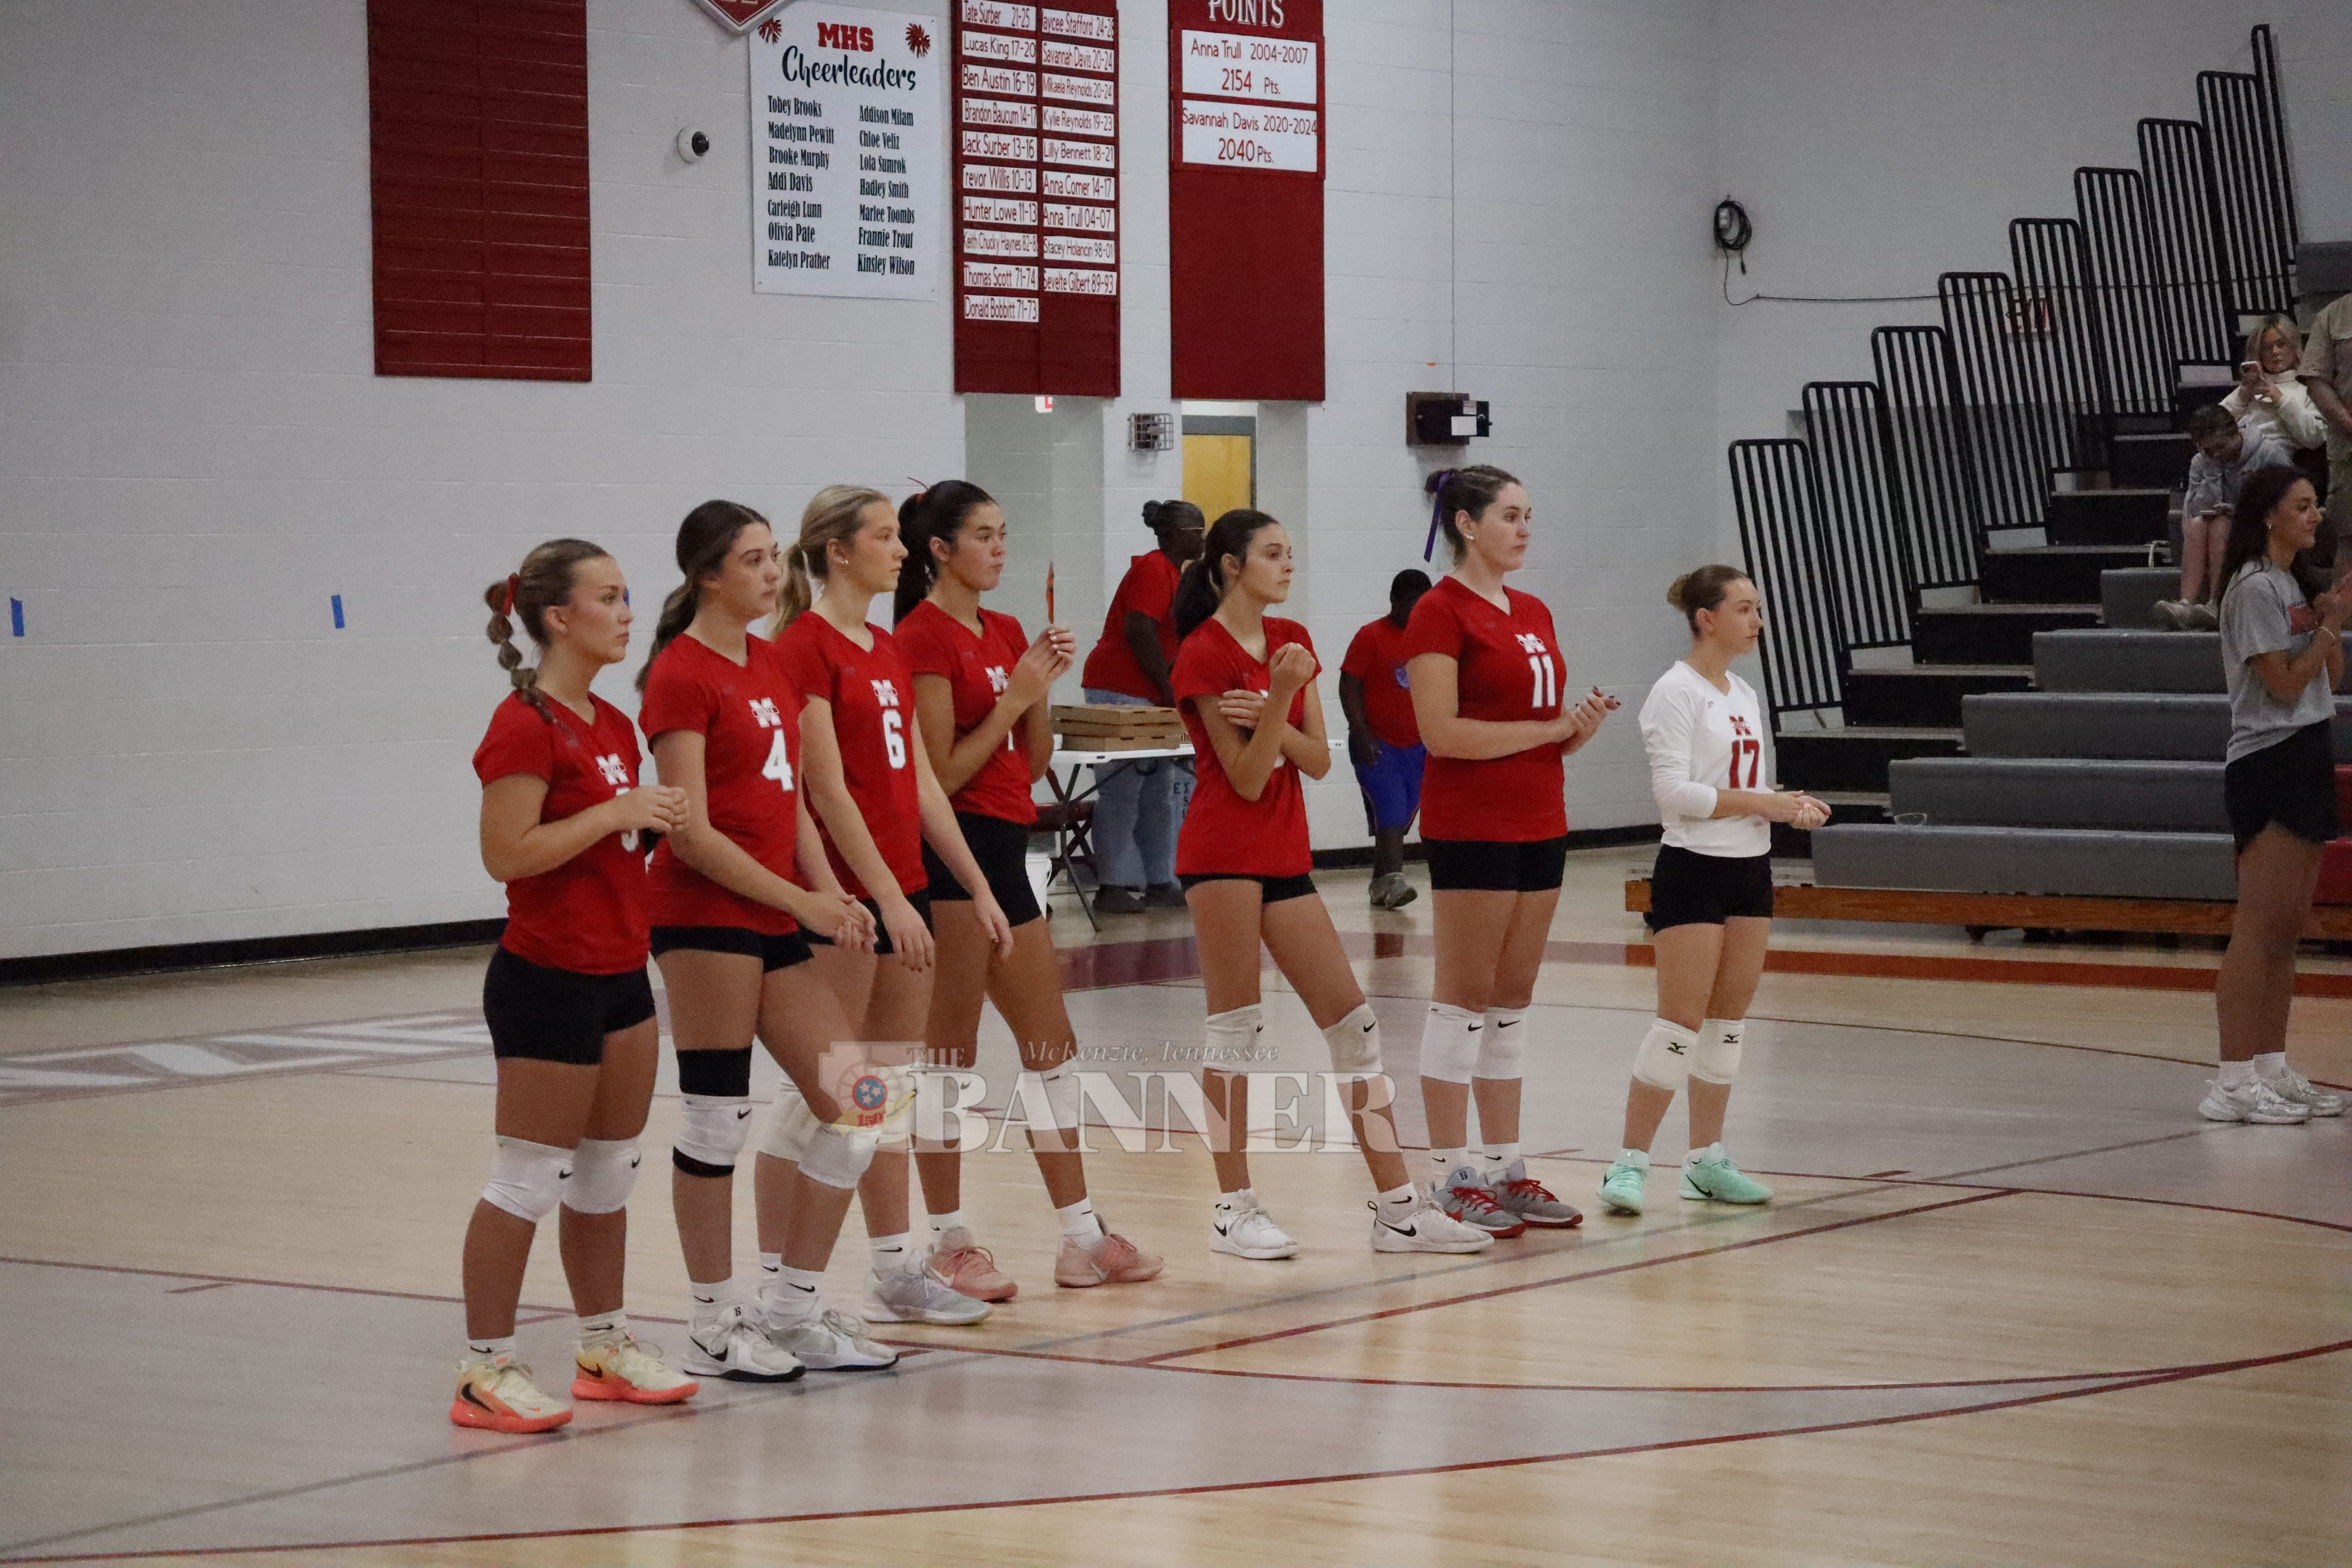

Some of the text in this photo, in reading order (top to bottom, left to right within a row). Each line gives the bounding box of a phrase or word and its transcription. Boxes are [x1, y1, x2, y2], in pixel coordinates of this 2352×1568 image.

[964, 0, 1030, 28] Tate Surber 21-25
[1065, 13, 1093, 36] Stafford
[817, 22, 874, 52] MHS
[964, 34, 1036, 60] Lucas King 17-20
[1043, 43, 1112, 71] Savannah Davis 20-24
[1191, 38, 1308, 64] Anna Trull 2004-2007
[782, 45, 916, 91] Cheerleaders
[963, 65, 1035, 93] Ben Austin 16-19
[1043, 75, 1112, 100] Mikaela Reynolds 20-24
[1222, 68, 1280, 94] 2154 Pts.
[768, 95, 822, 117] Tobey Brooks
[859, 105, 889, 124] Addison
[965, 100, 1037, 126] Brandon Baucum 14-17
[1043, 109, 1112, 132] Kylie Reynolds 19-23
[1183, 108, 1317, 136] Savannah Davis 2020-2024
[768, 121, 834, 145] Madelynn Pewitt
[859, 130, 900, 150] Chloe Veliz
[769, 147, 829, 169] Brooke Murphy
[963, 133, 1034, 159] Jack Surber 13-16
[1061, 142, 1091, 160] Bennett
[1094, 145, 1114, 162] 18-21
[1218, 138, 1273, 163] 2040 Pts.
[860, 154, 906, 174] Lola Sumrok
[768, 172, 813, 192] Addi Davis
[860, 179, 909, 198] Hadley Smith
[963, 165, 1033, 191] revor Willis 10-13
[1044, 173, 1063, 194] Anna
[1093, 177, 1112, 197] 14-17
[768, 199, 822, 219] Carleigh Lunn
[859, 204, 915, 224] Marlee Toombs
[964, 196, 1037, 222] Hunter Lowe 11-13
[1043, 205, 1111, 229] Anna Trull 04-07
[768, 221, 815, 243] Olivia Pate
[858, 227, 913, 249] Frannie Trout
[979, 232, 1000, 256] Chucky
[1001, 233, 1021, 255] Haynes
[1022, 234, 1038, 252] 82-8
[768, 249, 830, 270] Katelyn Prather
[1044, 238, 1065, 258] Stacey
[1094, 243, 1113, 258] 98-01
[858, 254, 915, 275] Kinsley Wilson
[964, 264, 1035, 288] Thomas Scott 71-74
[1069, 271, 1090, 293] Gilbert
[1091, 273, 1114, 293] 89-93
[965, 296, 1037, 319] Donald Bobbitt 71-73
[1529, 654, 1556, 708] 11
[882, 708, 906, 769] 6
[761, 728, 795, 792] 4
[1729, 739, 1760, 789] 17
